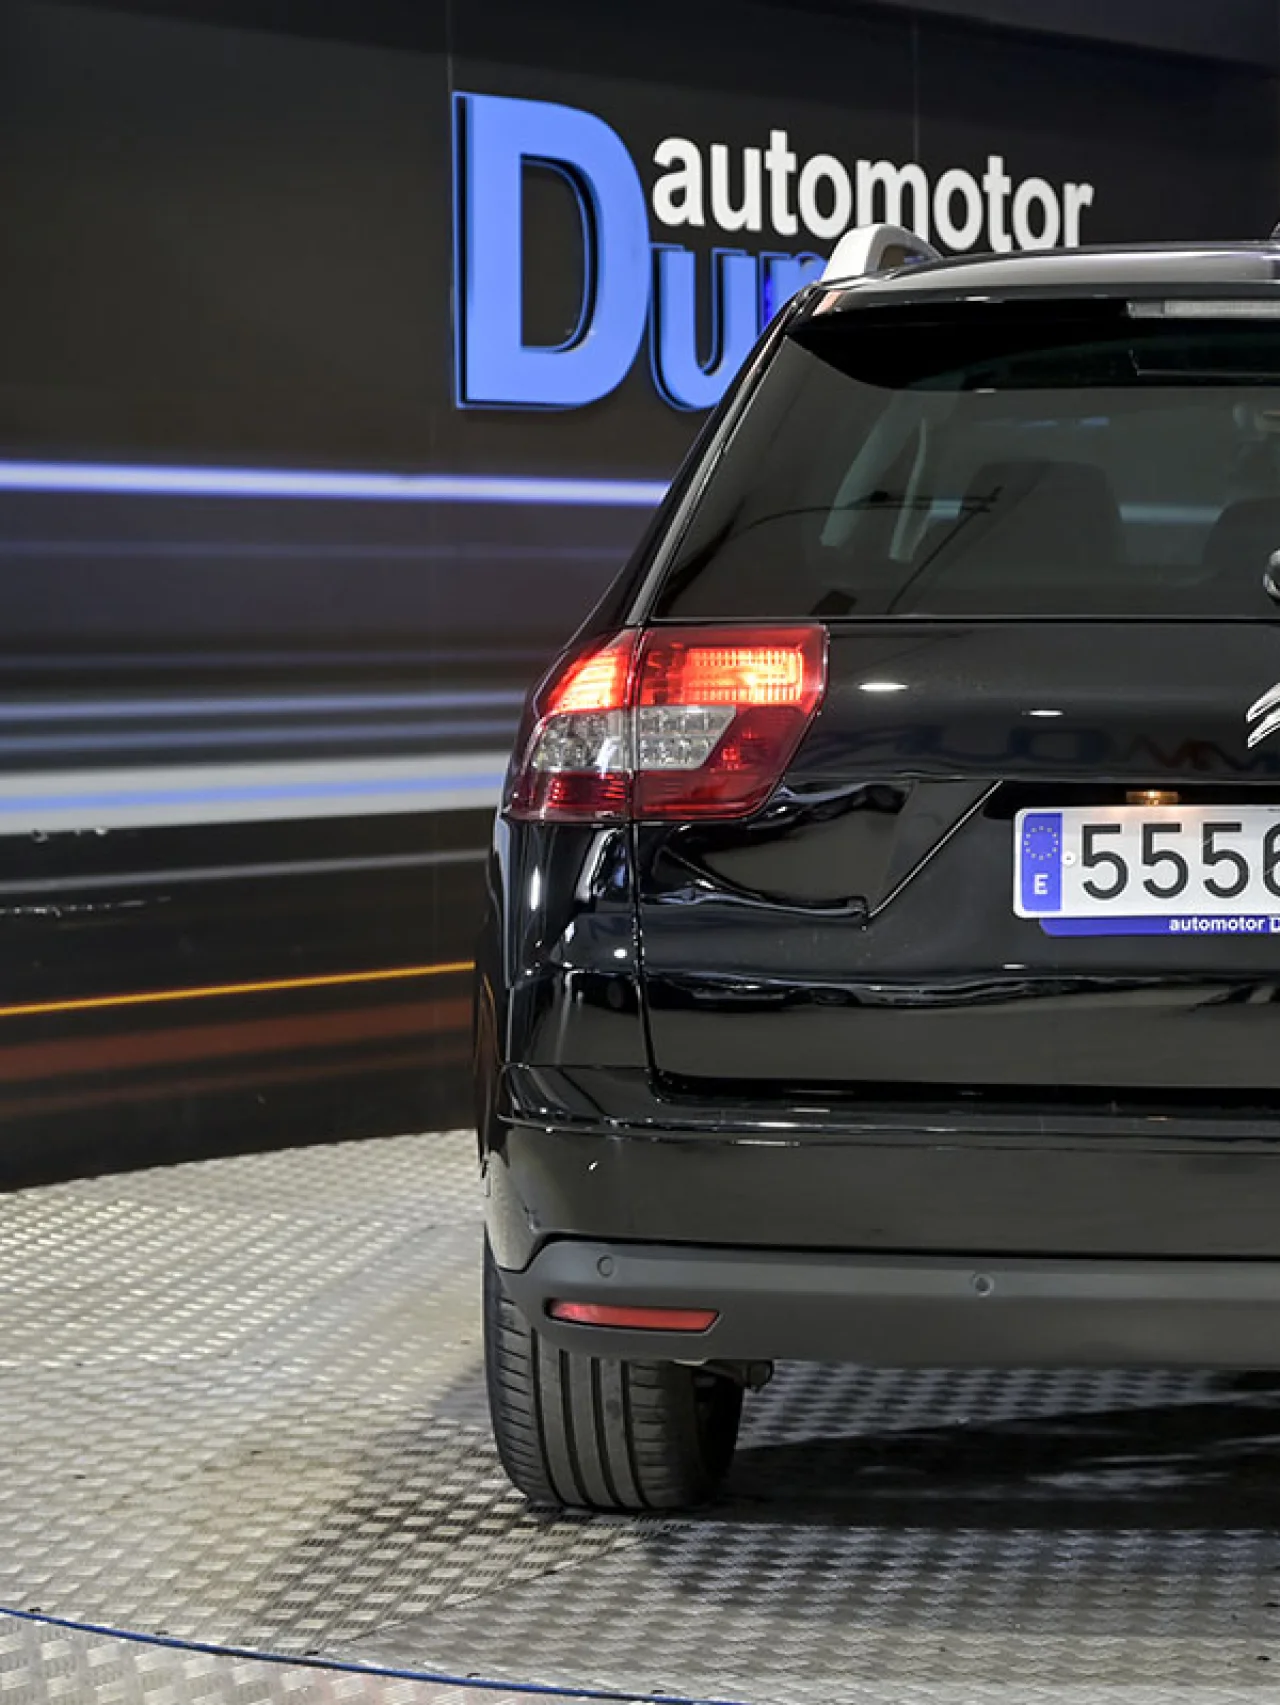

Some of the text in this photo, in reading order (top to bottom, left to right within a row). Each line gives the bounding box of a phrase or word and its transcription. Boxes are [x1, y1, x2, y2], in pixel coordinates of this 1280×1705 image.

[653, 129, 1093, 253] automotor
[1034, 875, 1048, 895] E
[1169, 916, 1265, 931] automotor
